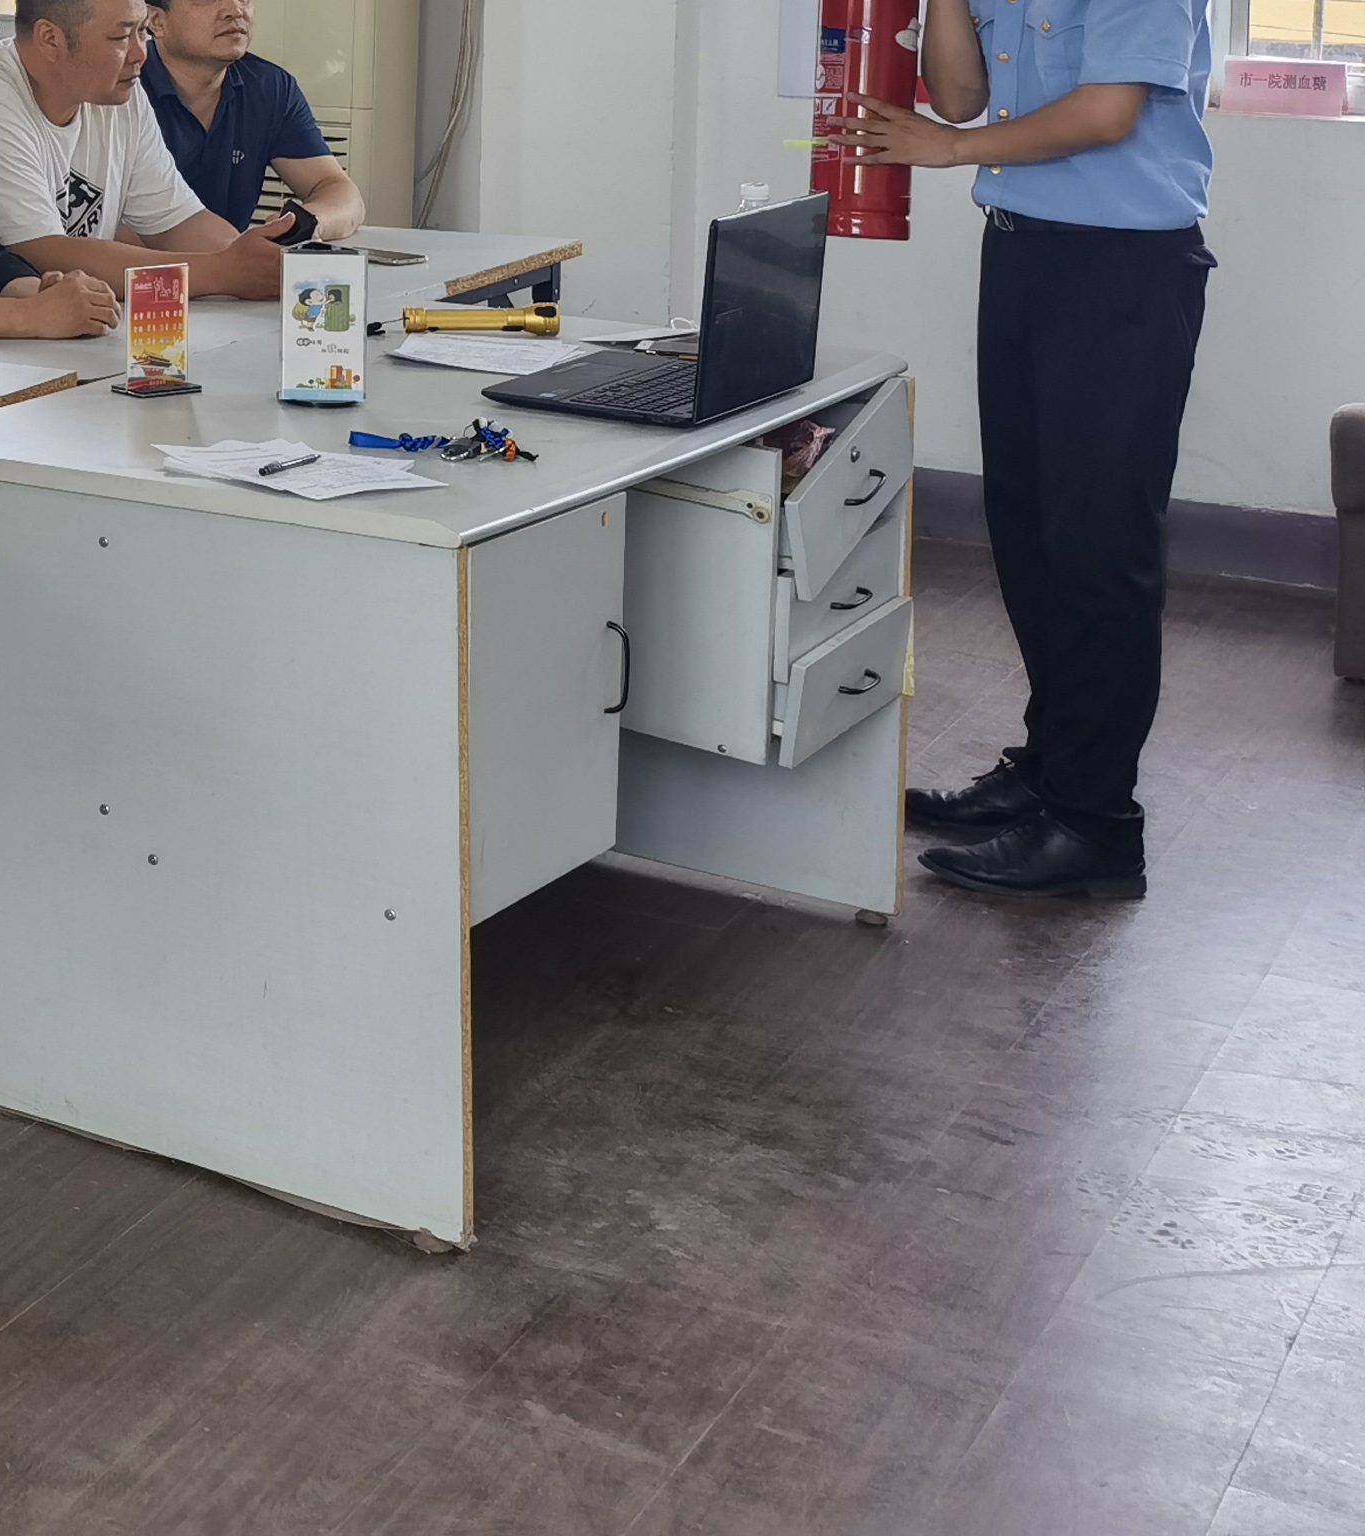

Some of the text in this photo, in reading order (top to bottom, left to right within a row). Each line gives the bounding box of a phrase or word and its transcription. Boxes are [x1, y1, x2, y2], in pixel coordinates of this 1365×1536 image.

[1239, 72, 1327, 91] 市一院测血糖
